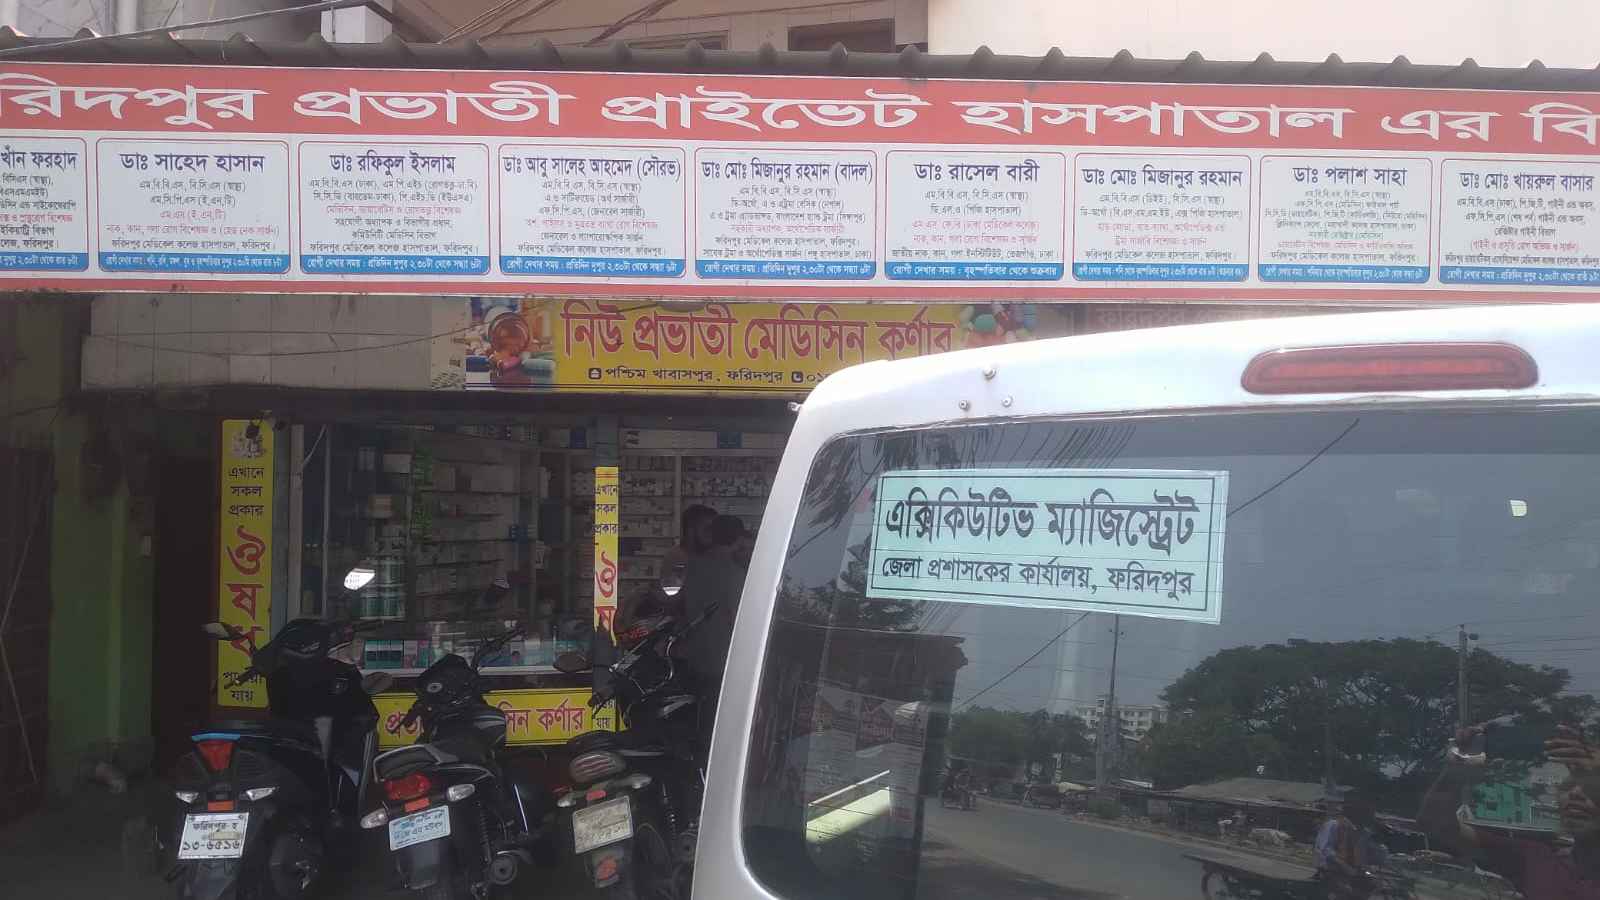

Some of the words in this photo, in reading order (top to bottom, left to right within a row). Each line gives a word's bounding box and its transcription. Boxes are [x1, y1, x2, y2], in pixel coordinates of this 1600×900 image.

[0, 73, 269, 129] রিদপুর
[294, 80, 576, 125] প্রভাতী
[601, 85, 931, 132] প্রাইভেট
[951, 98, 1357, 138] হাসপাতাল
[1381, 110, 1503, 142] এর
[1520, 102, 1600, 146] বি
[30, 150, 79, 172] ফরহাদ
[120, 152, 148, 171] ডাঃ
[154, 152, 209, 172] সাহেদ
[214, 153, 265, 173] হাসান
[329, 152, 352, 173] ডাঃ
[356, 149, 405, 177] রফিকুল
[408, 150, 457, 174] ইসলাম
[503, 156, 522, 174] ডাঃ
[524, 156, 549, 178] আবু
[551, 157, 586, 176] সালেহ
[589, 158, 633, 177] আহমেদ
[636, 156, 681, 183] (সৌরভ)
[702, 160, 720, 179] ডাঃ
[724, 160, 747, 179] মোঃ
[751, 157, 791, 183] মিজানুর
[795, 162, 832, 181] রহমান
[835, 162, 873, 184] (বাদল)
[913, 161, 941, 181] ডাঃ
[948, 161, 1000, 182] রাসেল
[1005, 159, 1040, 183] বারী
[1082, 167, 1105, 185] ডাঃ
[1110, 168, 1137, 185] মোঃ
[1142, 164, 1194, 189] মিজানুর
[1198, 169, 1243, 187] রহমান
[1292, 166, 1318, 184] ডাঃ
[1324, 167, 1368, 185] পলাশ
[1374, 167, 1408, 186] সাহা
[1459, 172, 1480, 189] ডাঃ
[1484, 173, 1509, 190] মোঃ
[1514, 172, 1557, 191] খায়রুল
[1560, 174, 1595, 192] বাসার
[560, 300, 626, 360] নিউ
[633, 302, 738, 361] প্রভাতী
[745, 303, 869, 363] মেডিসিন
[605, 365, 648, 379] পশ্চিম
[727, 367, 784, 383] ফরিদপুর
[228, 466, 265, 479] এখানে
[230, 485, 264, 498] সকল
[227, 503, 265, 518] প্রকার
[885, 486, 1038, 543] এক্সিকিউটিভ
[1045, 488, 1200, 554] ম্যাজিস্ট্রেট
[883, 556, 923, 579] জেলা
[928, 557, 1013, 584] প্রশাসকের
[1018, 555, 1098, 595] কার্যালয়,
[1106, 561, 1195, 599] ফরিদপুর
[535, 698, 586, 734] কর্ণার
